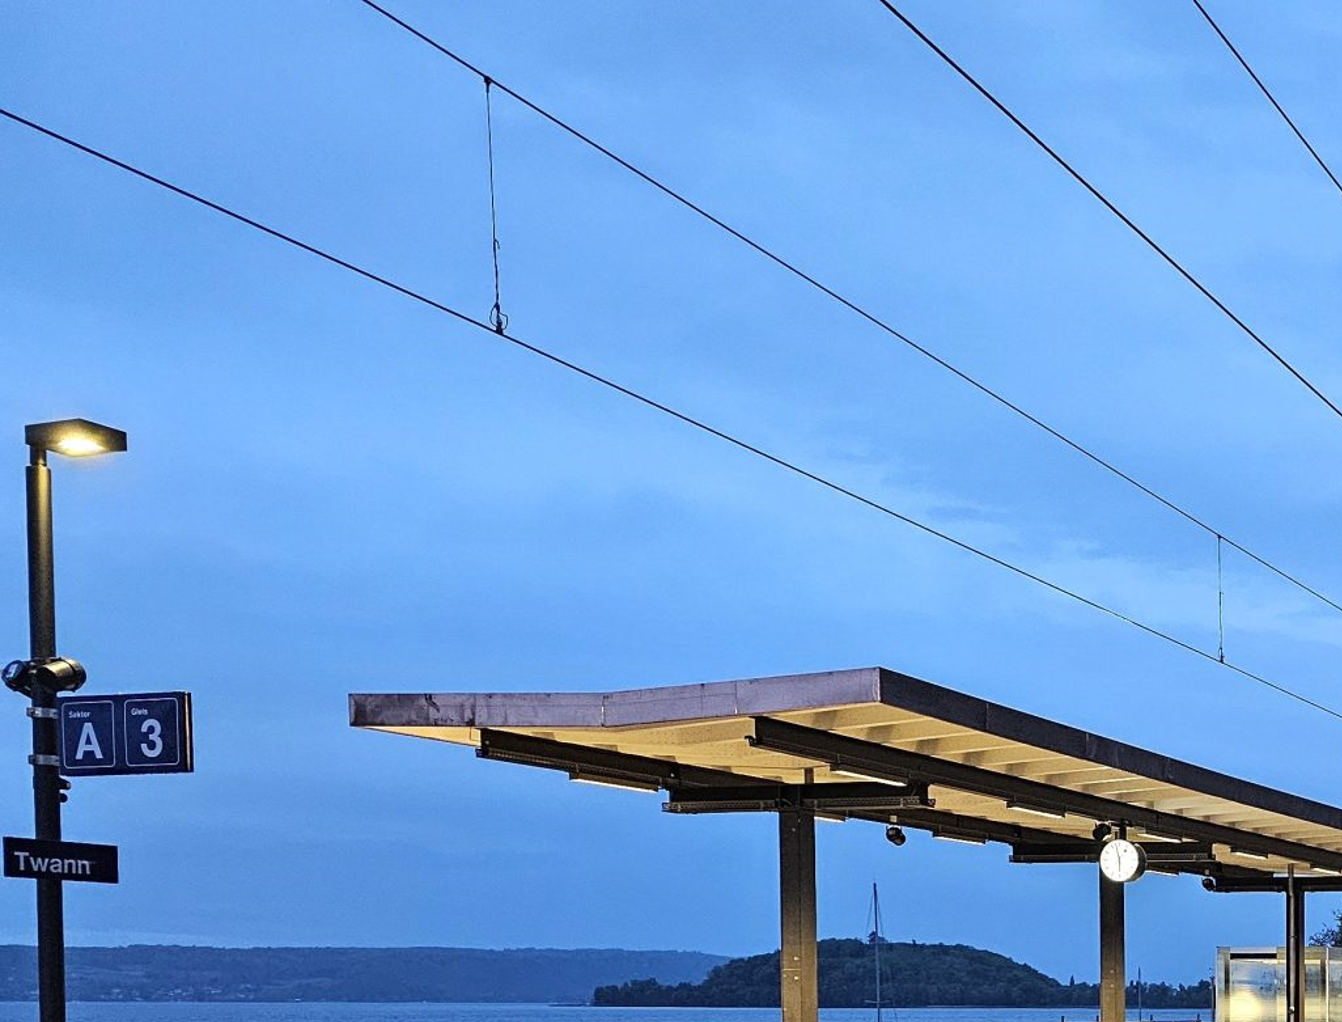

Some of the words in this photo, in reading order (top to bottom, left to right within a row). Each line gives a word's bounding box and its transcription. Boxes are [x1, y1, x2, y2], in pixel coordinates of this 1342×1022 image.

[68, 710, 91, 719] Sektor
[75, 722, 104, 760] A
[140, 718, 163, 758] 3
[14, 851, 91, 875] Twann
